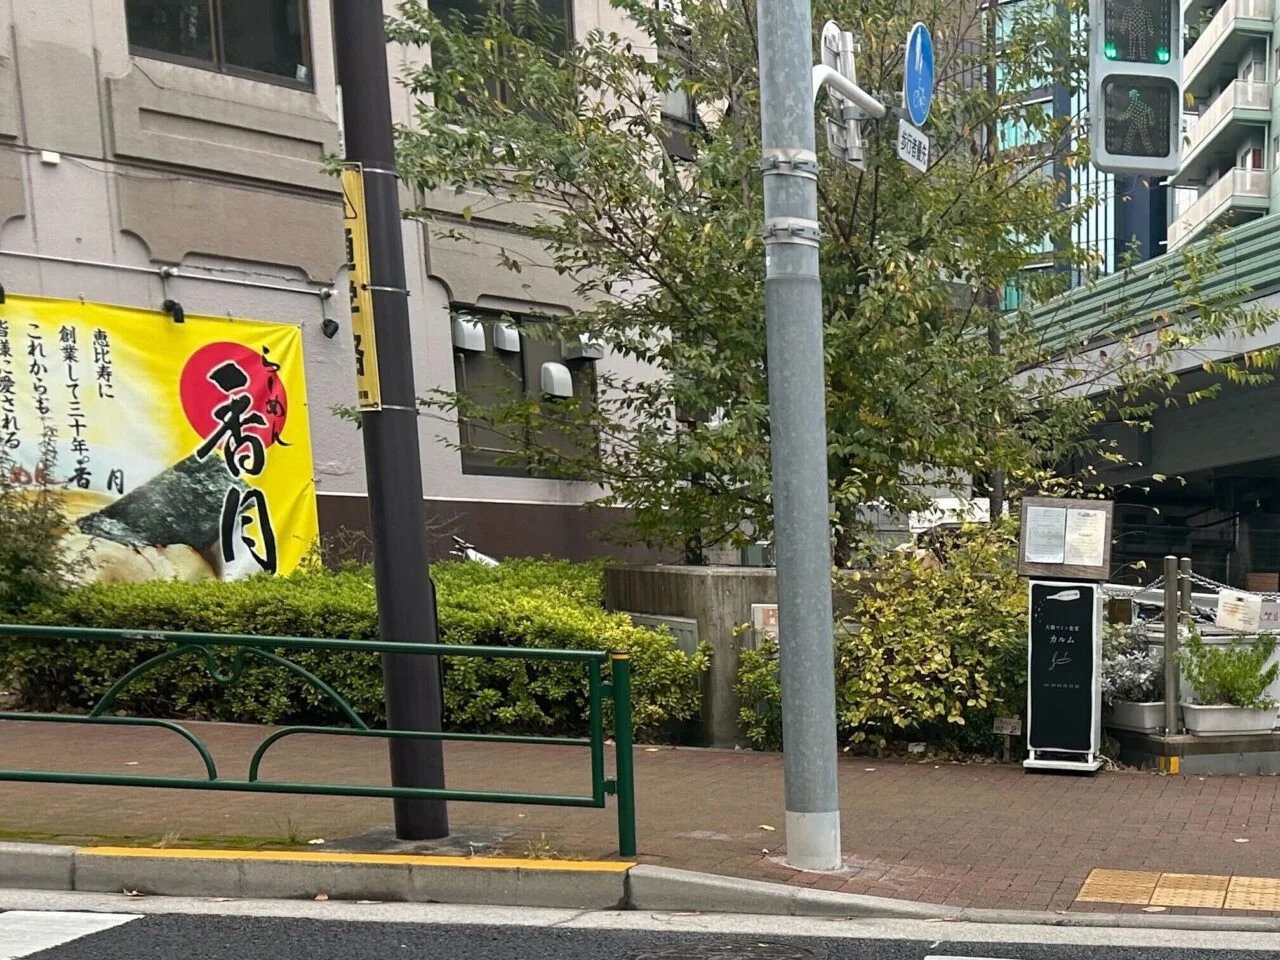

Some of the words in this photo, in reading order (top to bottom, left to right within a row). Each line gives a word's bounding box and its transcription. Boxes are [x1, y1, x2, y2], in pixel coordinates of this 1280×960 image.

[900, 130, 927, 165] 歩行者優先
[93, 328, 114, 398] 恵比寿に
[261, 344, 293, 446] らーめん
